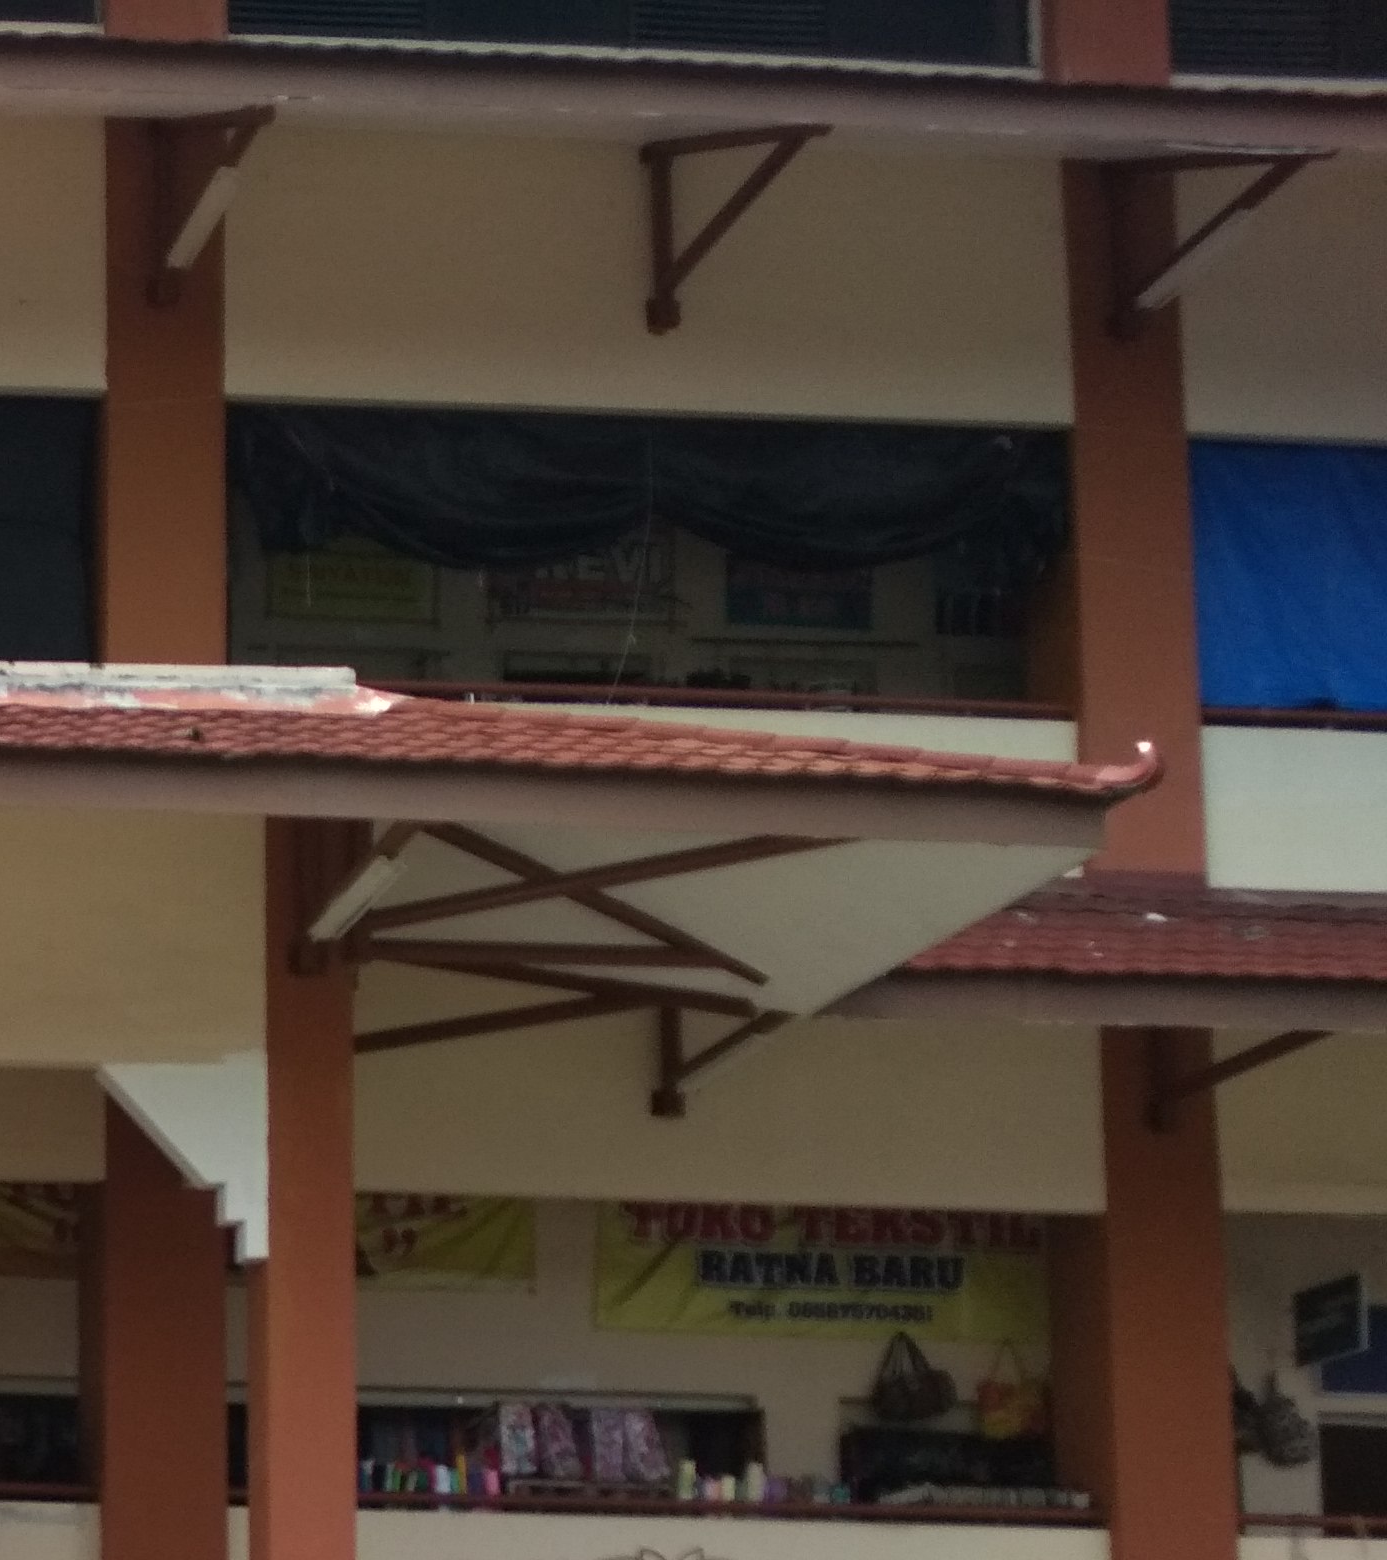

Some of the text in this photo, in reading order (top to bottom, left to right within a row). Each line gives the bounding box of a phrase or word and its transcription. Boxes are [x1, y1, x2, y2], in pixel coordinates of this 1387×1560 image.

[623, 1203, 776, 1243] TOKO
[698, 1249, 966, 1290] RATNA BARU
